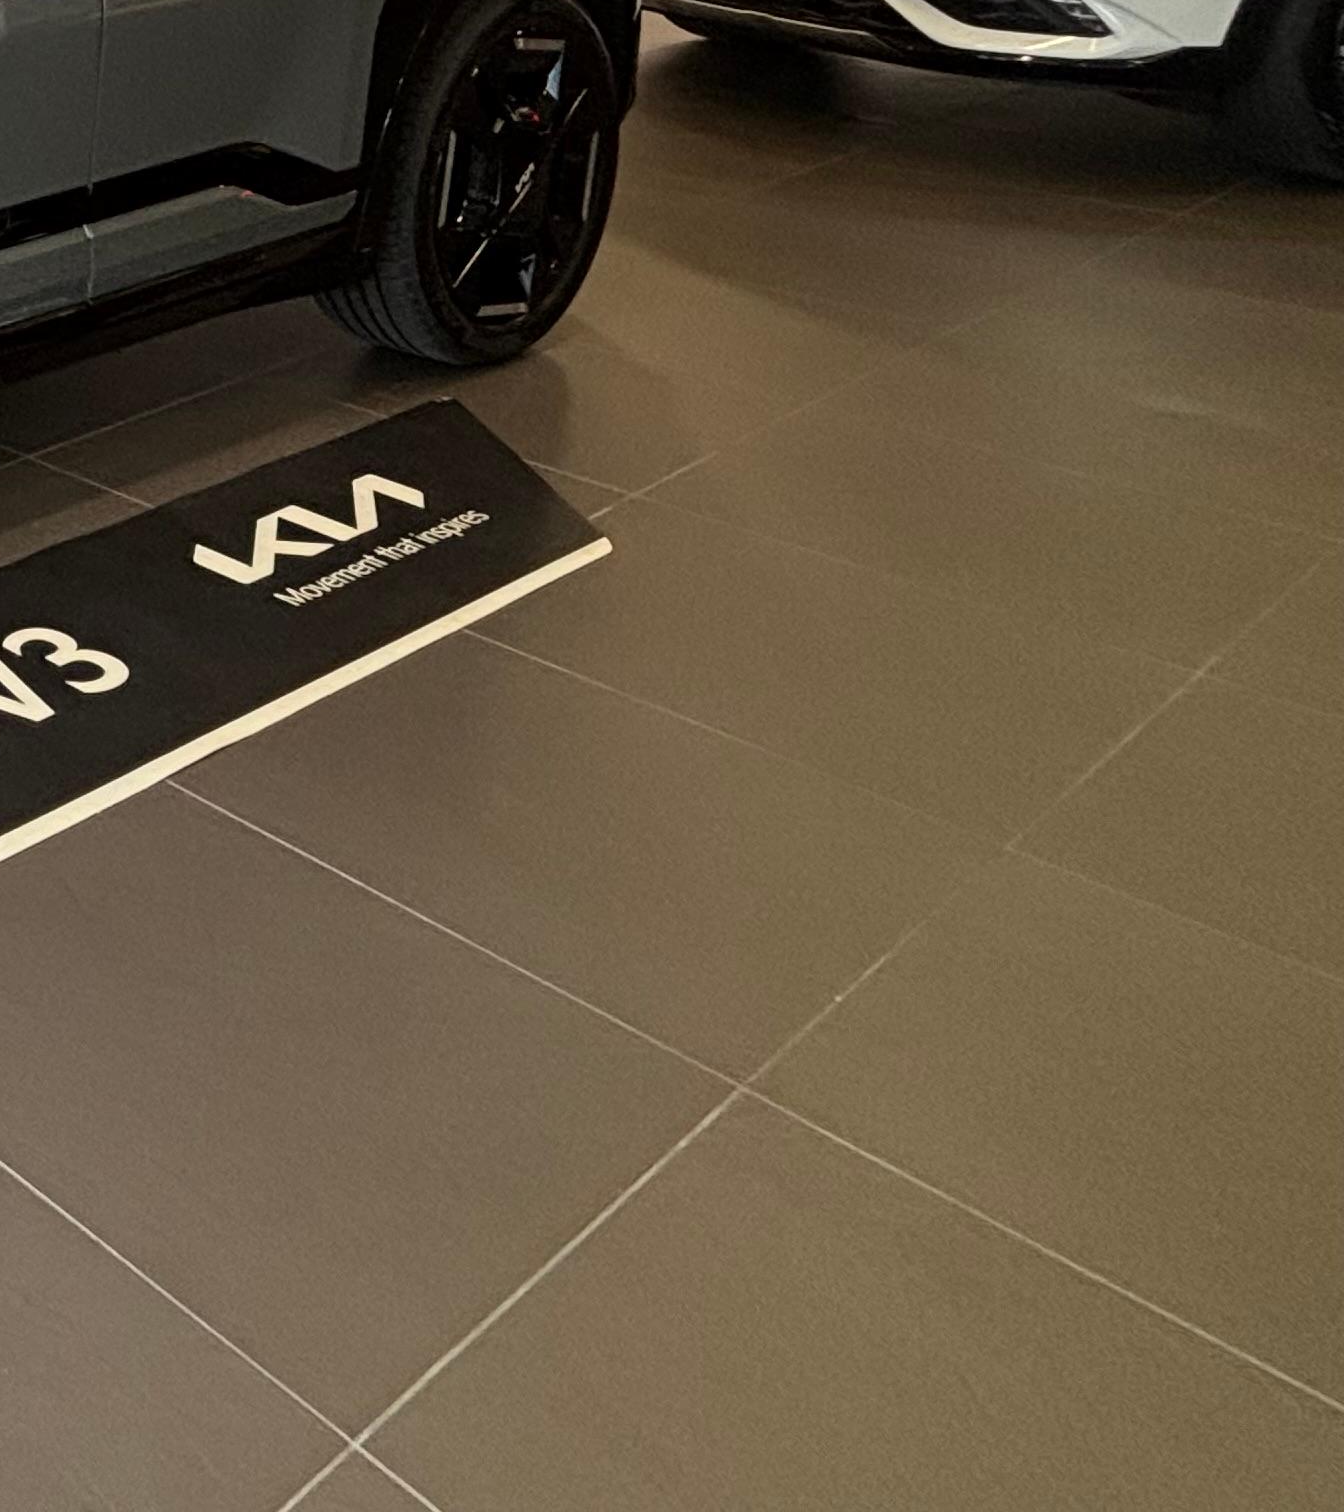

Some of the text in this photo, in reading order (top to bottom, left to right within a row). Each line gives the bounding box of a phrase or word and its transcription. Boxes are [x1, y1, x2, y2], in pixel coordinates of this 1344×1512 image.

[193, 473, 425, 584] KIA
[273, 509, 490, 607] Movement that inspires
